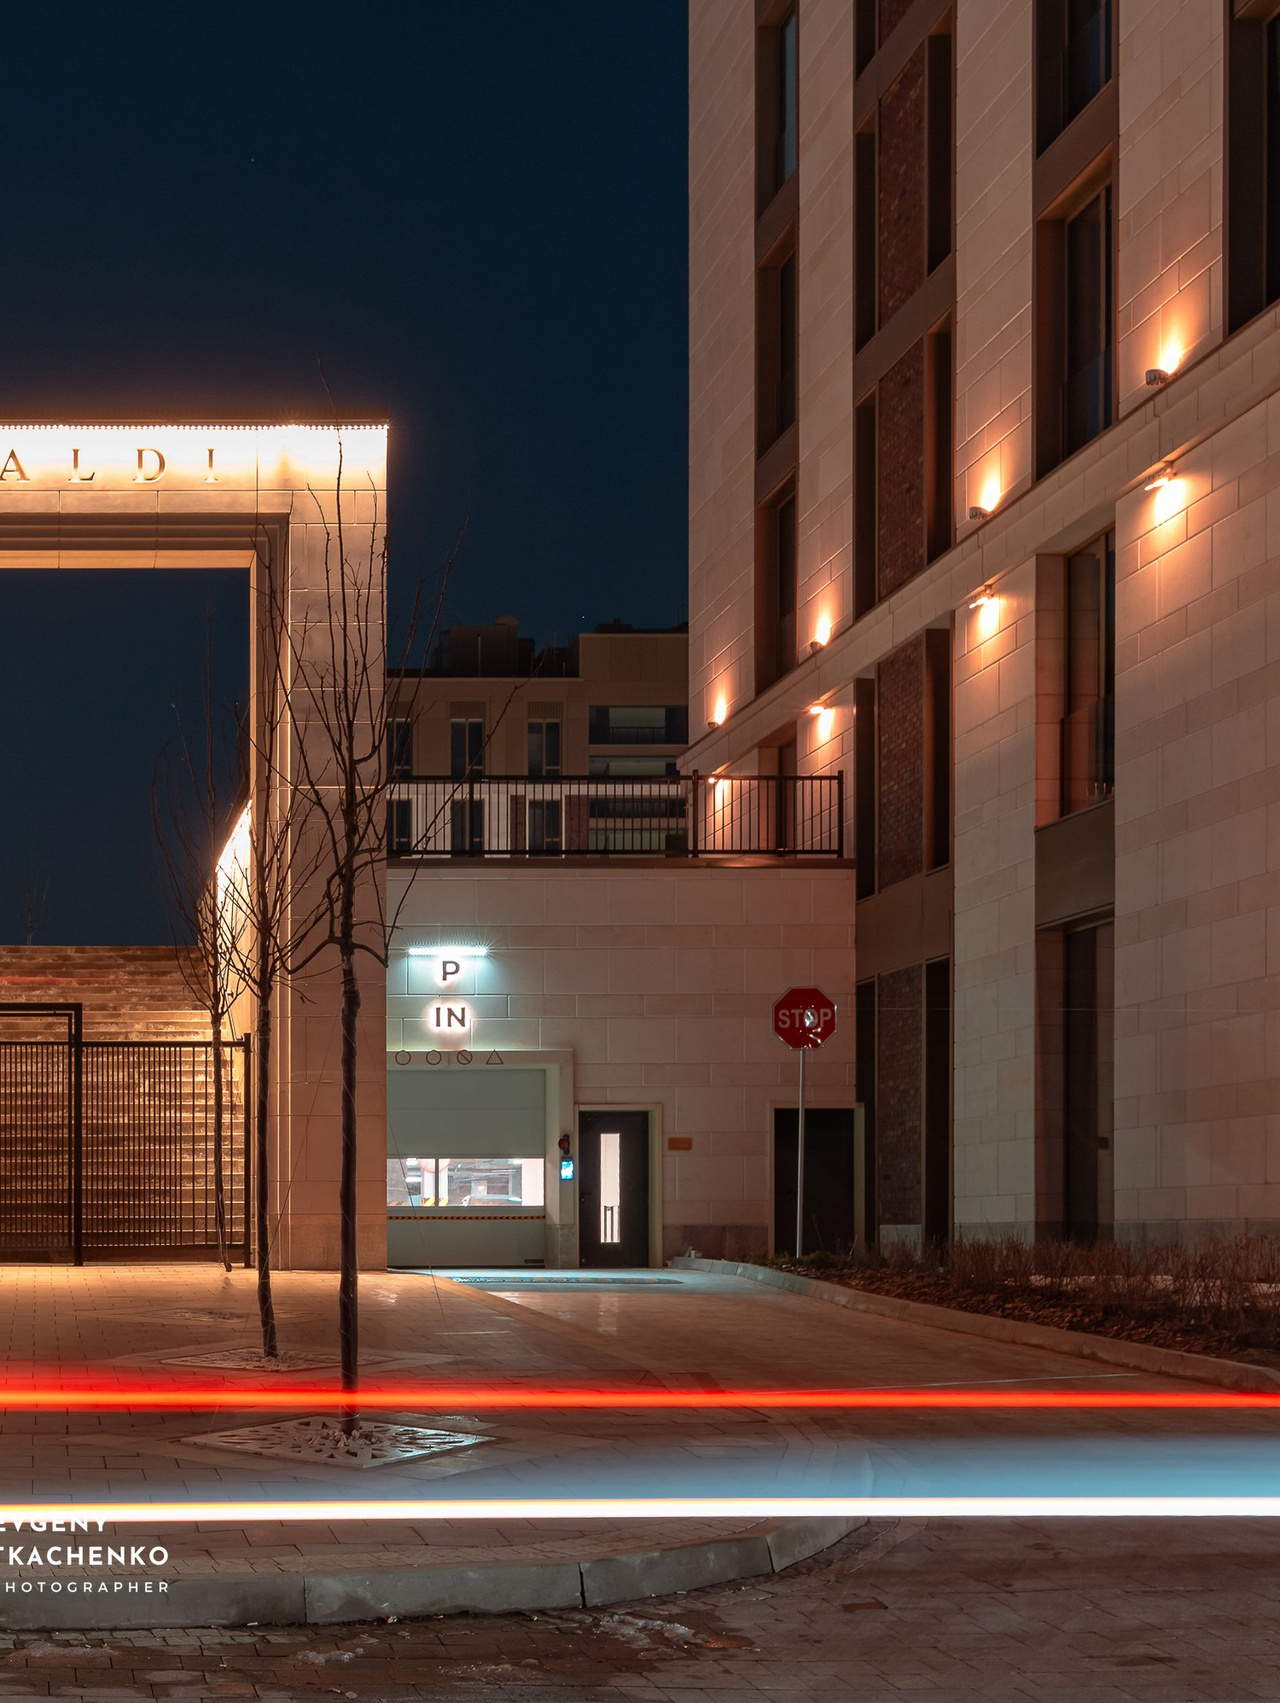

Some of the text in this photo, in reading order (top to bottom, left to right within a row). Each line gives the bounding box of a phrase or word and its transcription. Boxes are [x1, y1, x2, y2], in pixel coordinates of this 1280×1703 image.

[442, 960, 460, 981] P
[435, 1007, 466, 1028] IN
[777, 1008, 832, 1029] STOP
